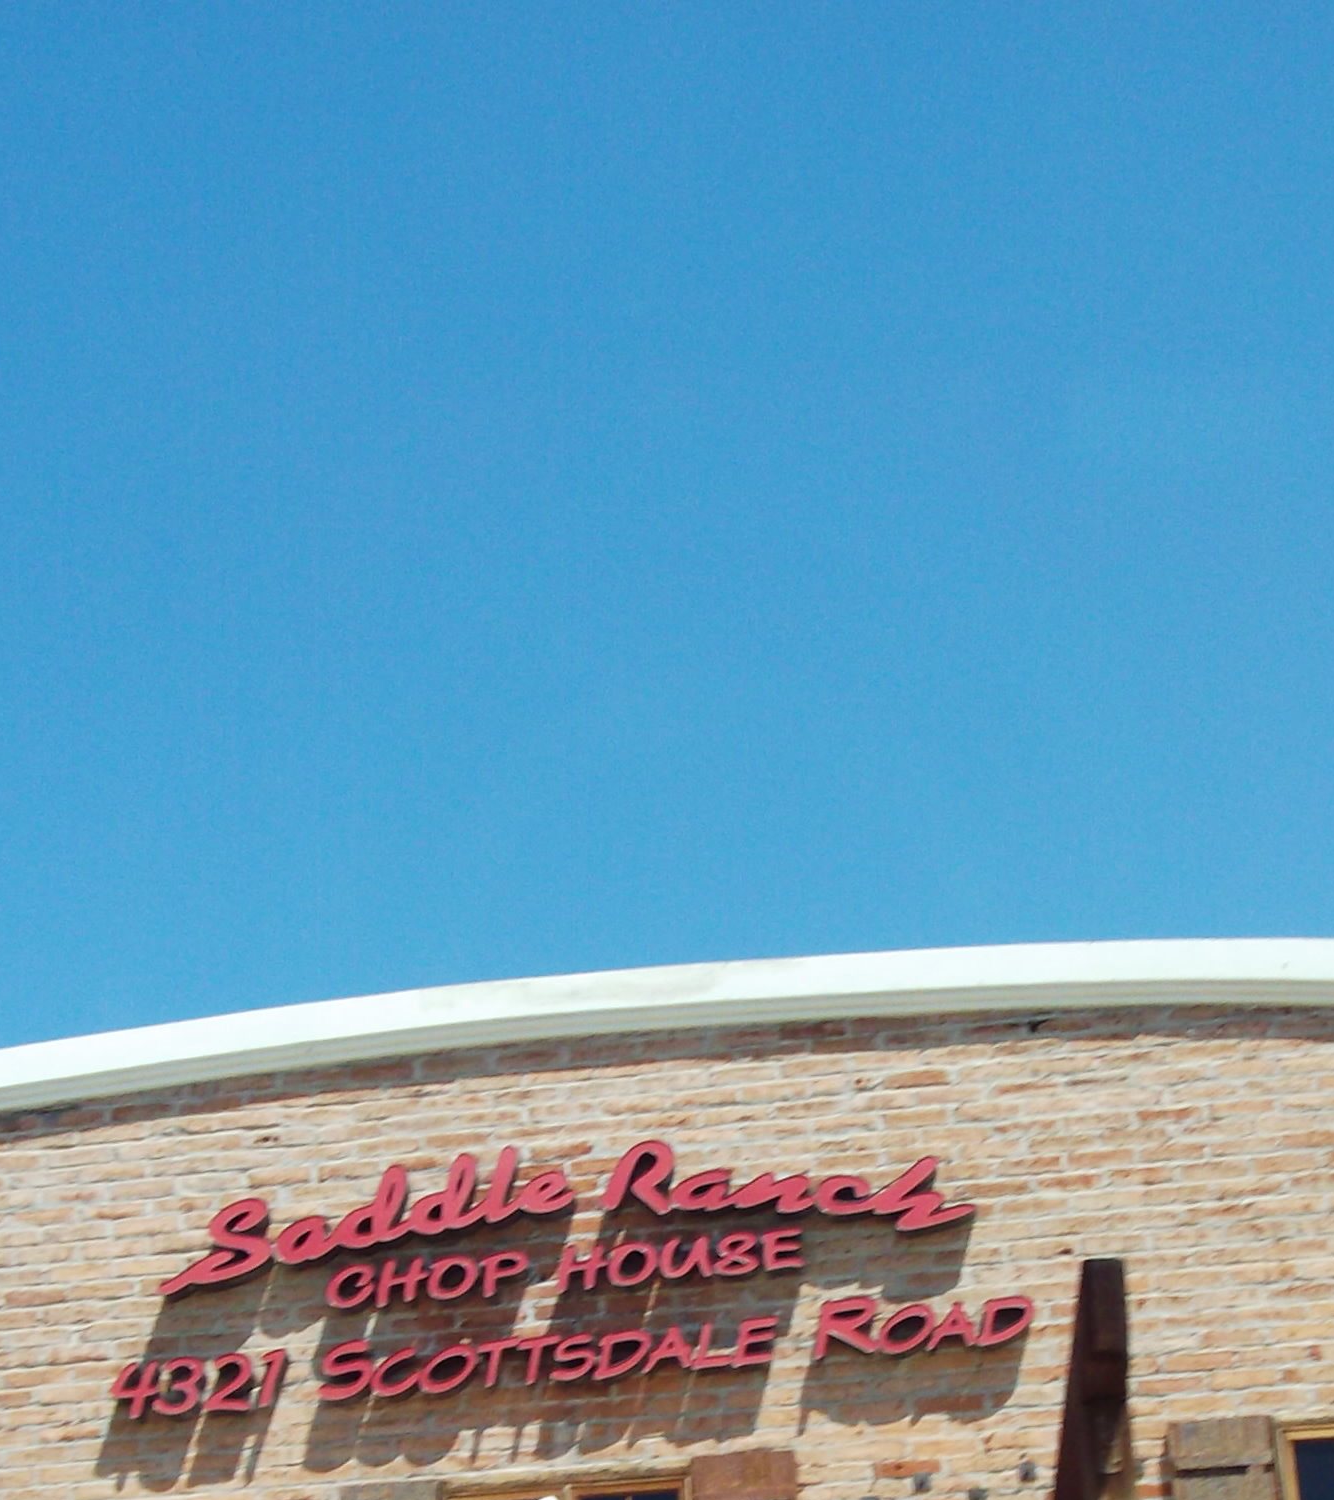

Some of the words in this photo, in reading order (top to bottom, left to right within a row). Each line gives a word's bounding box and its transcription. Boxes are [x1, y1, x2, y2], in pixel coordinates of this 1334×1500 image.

[159, 1145, 575, 1296] Saddle
[600, 1140, 976, 1232] Ranch
[325, 1250, 529, 1309] CHOP
[557, 1229, 805, 1292] HOUSE
[110, 1350, 287, 1418] 4321
[318, 1314, 780, 1400] SCOTTSDALE
[813, 1295, 1036, 1358] ROAD
